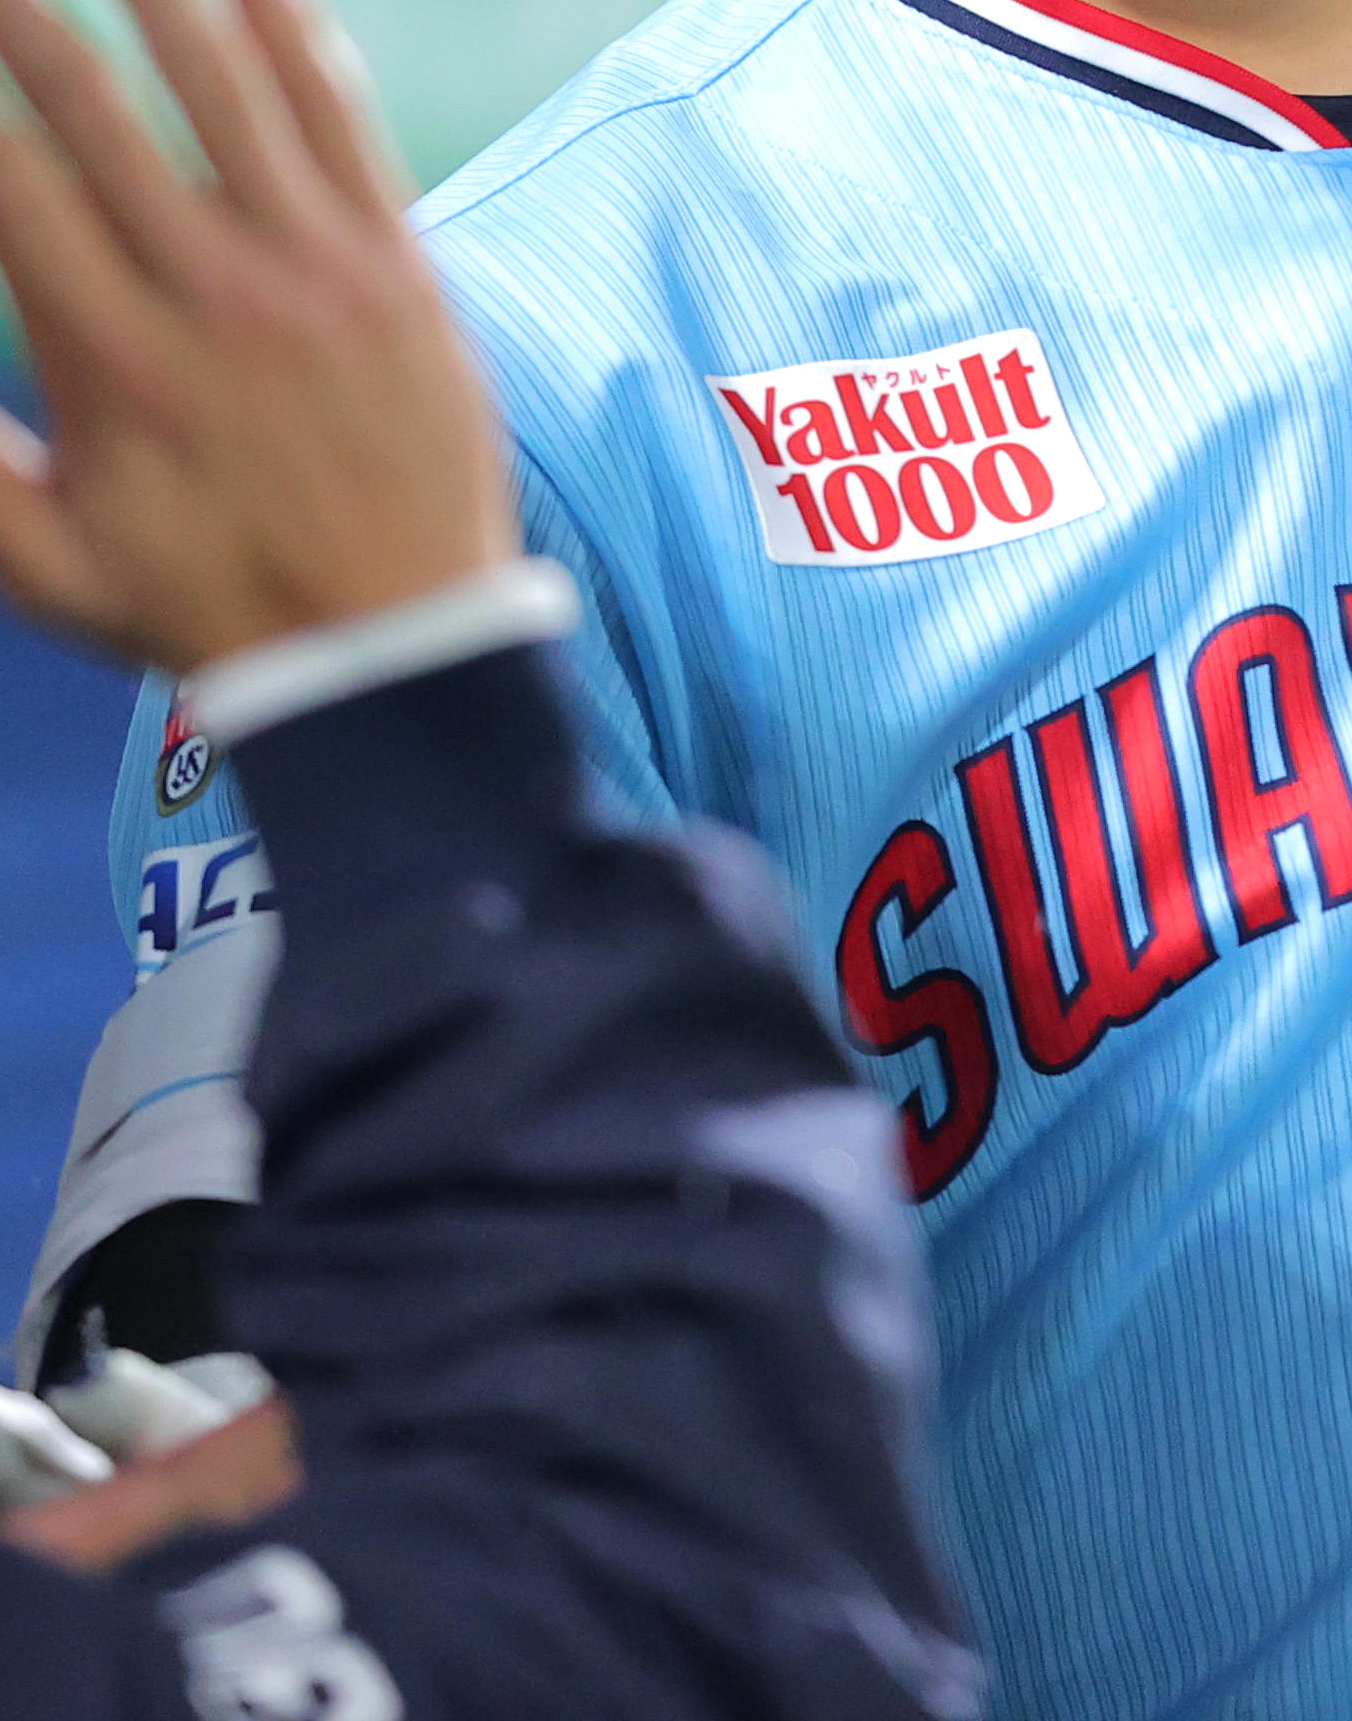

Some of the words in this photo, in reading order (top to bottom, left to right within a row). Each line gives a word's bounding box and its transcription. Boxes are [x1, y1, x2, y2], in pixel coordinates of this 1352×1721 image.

[720, 348, 1052, 467] Yakult
[861, 363, 953, 390] ヤクルト
[776, 442, 1055, 554] 1000
